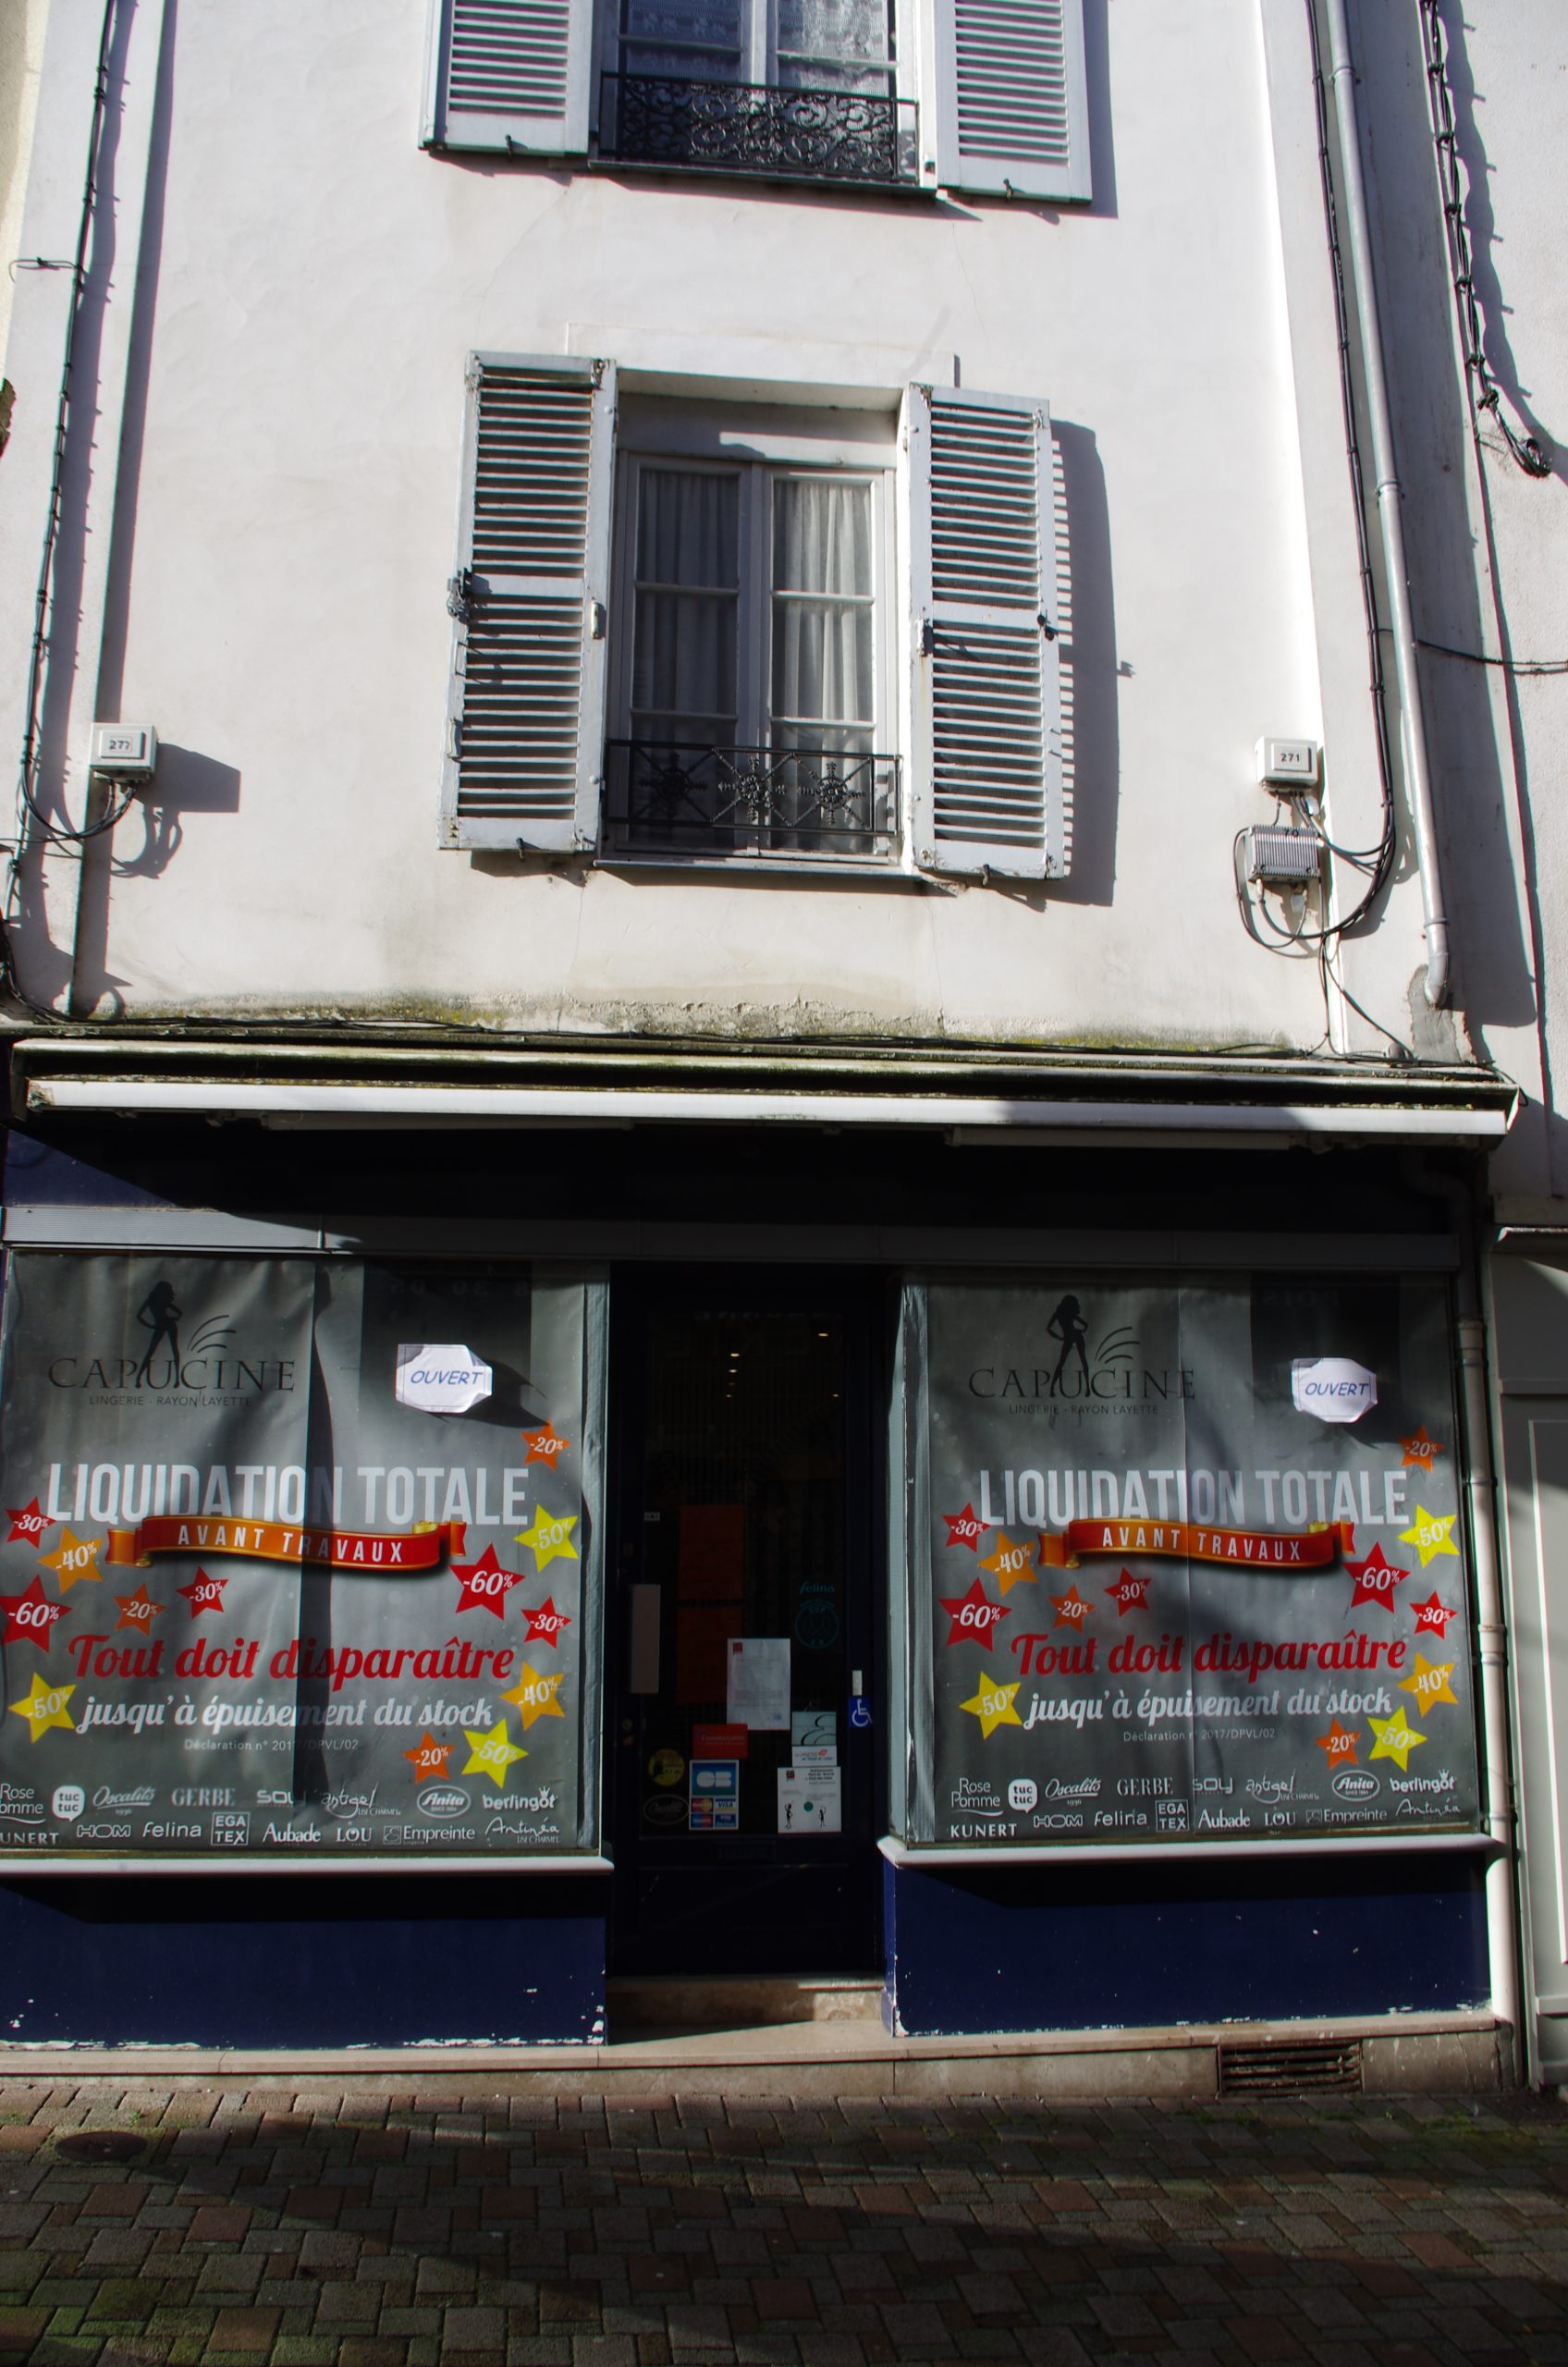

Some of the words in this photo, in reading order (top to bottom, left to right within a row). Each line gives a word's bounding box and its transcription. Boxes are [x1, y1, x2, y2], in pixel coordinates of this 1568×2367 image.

[1280, 753, 1301, 763] 271
[48, 1357, 295, 1392] CAPUCINE
[410, 1370, 484, 1385] OUVERT
[969, 1368, 1195, 1401] CAPUCINE
[1305, 1382, 1369, 1396] OUVERT
[90, 1395, 144, 1405] LINGERIE
[157, 1396, 197, 1406] RAYON
[202, 1396, 252, 1406] LAYETTE
[1009, 1405, 1059, 1415] LINGERIE
[1071, 1405, 1109, 1415] RAYON
[1113, 1404, 1158, 1415] LAYETTE
[530, 1436, 563, 1454] -20%
[1405, 1441, 1437, 1457] -20%
[47, 1463, 343, 1525] LIQUIDATION
[358, 1466, 529, 1525] TOTALE
[980, 1469, 1245, 1528] LIQUIDATION
[1255, 1469, 1410, 1525] TOTALE
[14, 1514, 49, 1532] -30%
[950, 1519, 984, 1537] -30%
[1415, 1518, 1451, 1547] -50%
[532, 1518, 571, 1550] -50%
[178, 1525, 264, 1549] AVANT
[283, 1532, 402, 1563] TRAVAUX
[1102, 1527, 1181, 1549] AVANT
[1198, 1532, 1301, 1561] TRAVAUX
[55, 1541, 97, 1571] -40%
[994, 1544, 1031, 1574] -40%
[463, 1570, 514, 1595] -60%
[1355, 1566, 1400, 1590] -60%
[190, 1581, 223, 1602] -30%
[1116, 1581, 1146, 1601] -30%
[8, 1601, 60, 1627] -60%
[122, 1600, 158, 1619] -20%
[952, 1603, 1000, 1629] -60%
[1058, 1600, 1088, 1618] -20%
[1418, 1607, 1451, 1625] -30%
[530, 1613, 565, 1632] -30%
[68, 1634, 165, 1678] Tout
[175, 1637, 260, 1678] doit
[269, 1635, 515, 1692] disparaître
[1011, 1633, 1097, 1675] Tout
[1108, 1633, 1185, 1674] doit
[1194, 1628, 1407, 1684] disparaître
[1413, 1666, 1449, 1695] -40%
[518, 1675, 558, 1707] -40%
[27, 1687, 70, 1720] -50%
[976, 1686, 1015, 1717] -50%
[1136, 1688, 1280, 1727] épuisement
[1286, 1687, 1320, 1715] du
[1326, 1686, 1393, 1714] stock
[202, 1695, 366, 1735] épuisement
[374, 1698, 412, 1726] du
[418, 1698, 493, 1726] stock
[184, 1739, 251, 1750] Déclaration
[1123, 1731, 1185, 1742] Déclaration
[1202, 1728, 1275, 1739] 2017/DPVL/02
[1326, 1734, 1355, 1753] -20%
[1377, 1727, 1416, 1749] -50%
[415, 1747, 448, 1767] -20%
[473, 1740, 518, 1764] -50%
[0, 1783, 35, 1800] Rose
[959, 1777, 991, 1794] Rose
[1013, 1784, 1033, 1794] tuc
[1117, 1777, 1173, 1797] GERBE
[1337, 1776, 1375, 1790] Anita
[59, 1792, 80, 1801] tuc
[171, 1787, 236, 1807] GERBE
[422, 1792, 465, 1806] Anita
[951, 1791, 1000, 1809] Pomme
[1013, 1795, 1034, 1804] tuc
[0, 1802, 44, 1814] omme
[58, 1802, 80, 1812] tuc
[1158, 1803, 1186, 1814] EGA
[1324, 1807, 1387, 1824] Empreinte
[214, 1815, 247, 1827] EGA
[1034, 1814, 1084, 1828] HOM
[1159, 1817, 1187, 1831] TEX
[1198, 1808, 1251, 1829] Aubade
[0, 1832, 59, 1845] UNERT
[77, 1824, 131, 1838] HOM
[214, 1830, 247, 1845] TEX
[263, 1821, 322, 1843] Aubade
[404, 1825, 475, 1844] Empreinte
[950, 1822, 1017, 1838] KUNERT
